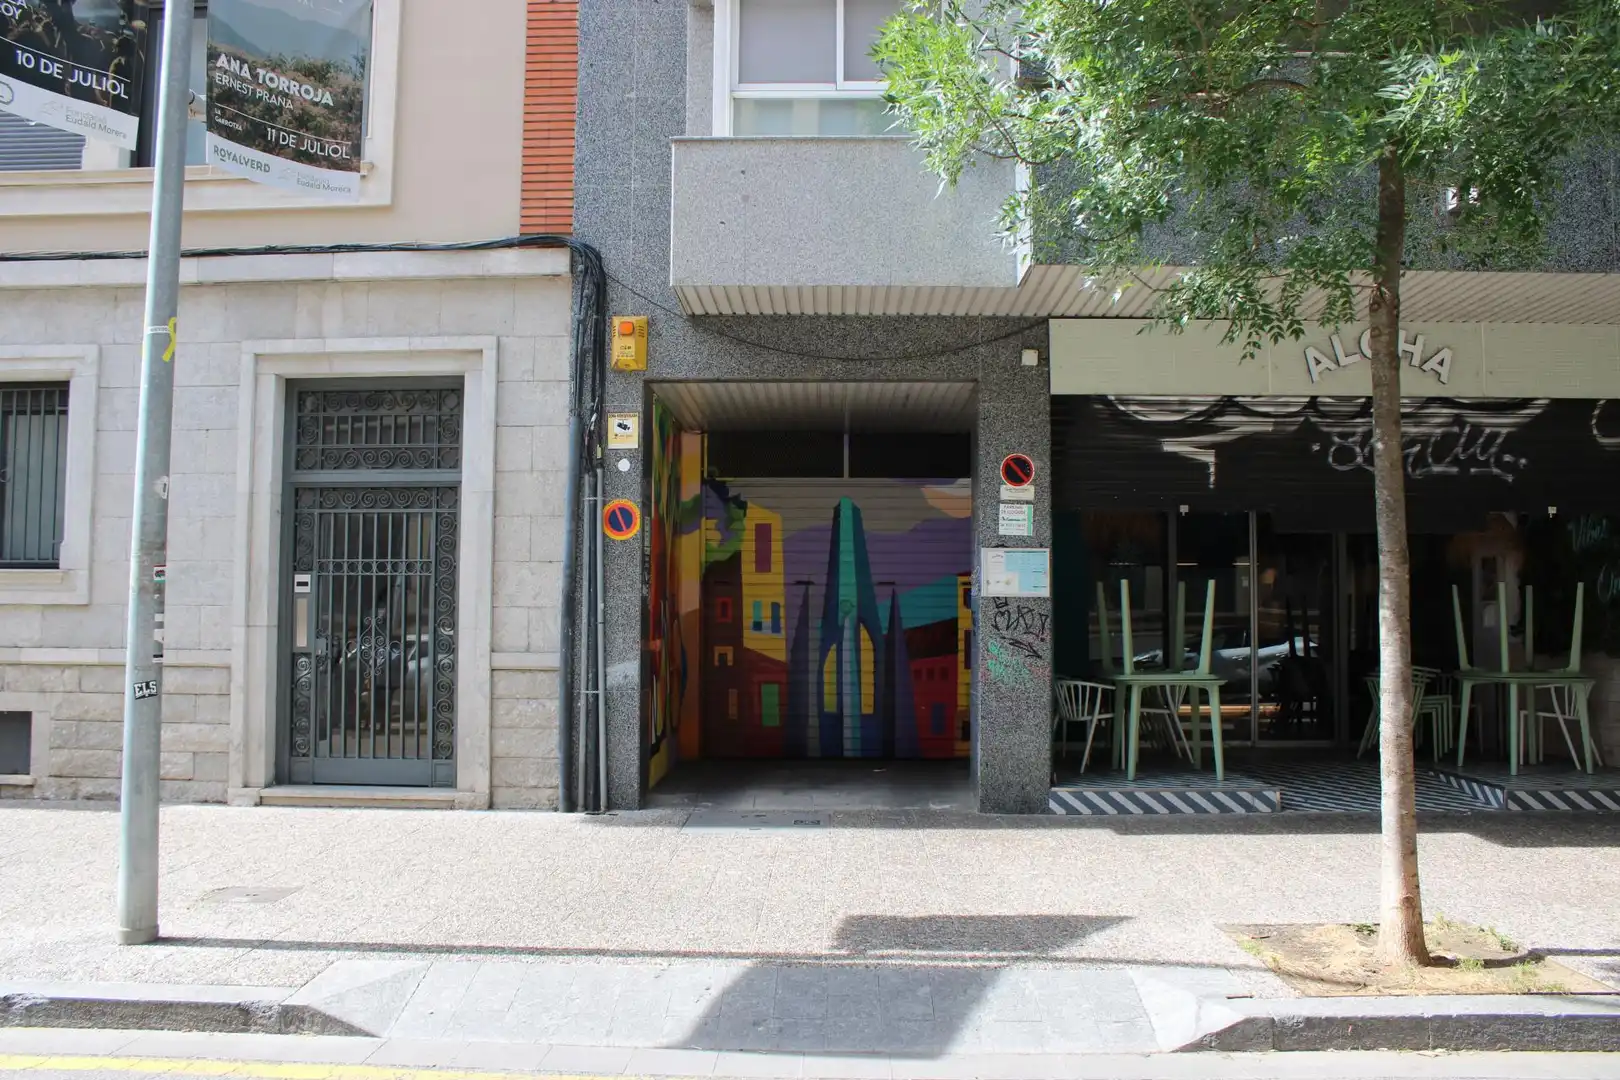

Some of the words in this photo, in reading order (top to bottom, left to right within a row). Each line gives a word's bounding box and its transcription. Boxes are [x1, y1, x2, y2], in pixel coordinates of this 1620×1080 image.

[16, 50, 35, 68] 10
[40, 57, 64, 79] DE
[68, 69, 129, 99] JULIOL
[215, 72, 254, 97] ERNEST
[256, 89, 293, 110] PRANA
[216, 53, 252, 80] ANA
[256, 68, 334, 106] TORROJA
[213, 144, 271, 173] ROYALVERD
[266, 127, 276, 142] 11
[279, 131, 297, 149] DE
[299, 138, 351, 159] JULIOL
[134, 681, 157, 699] ELS
